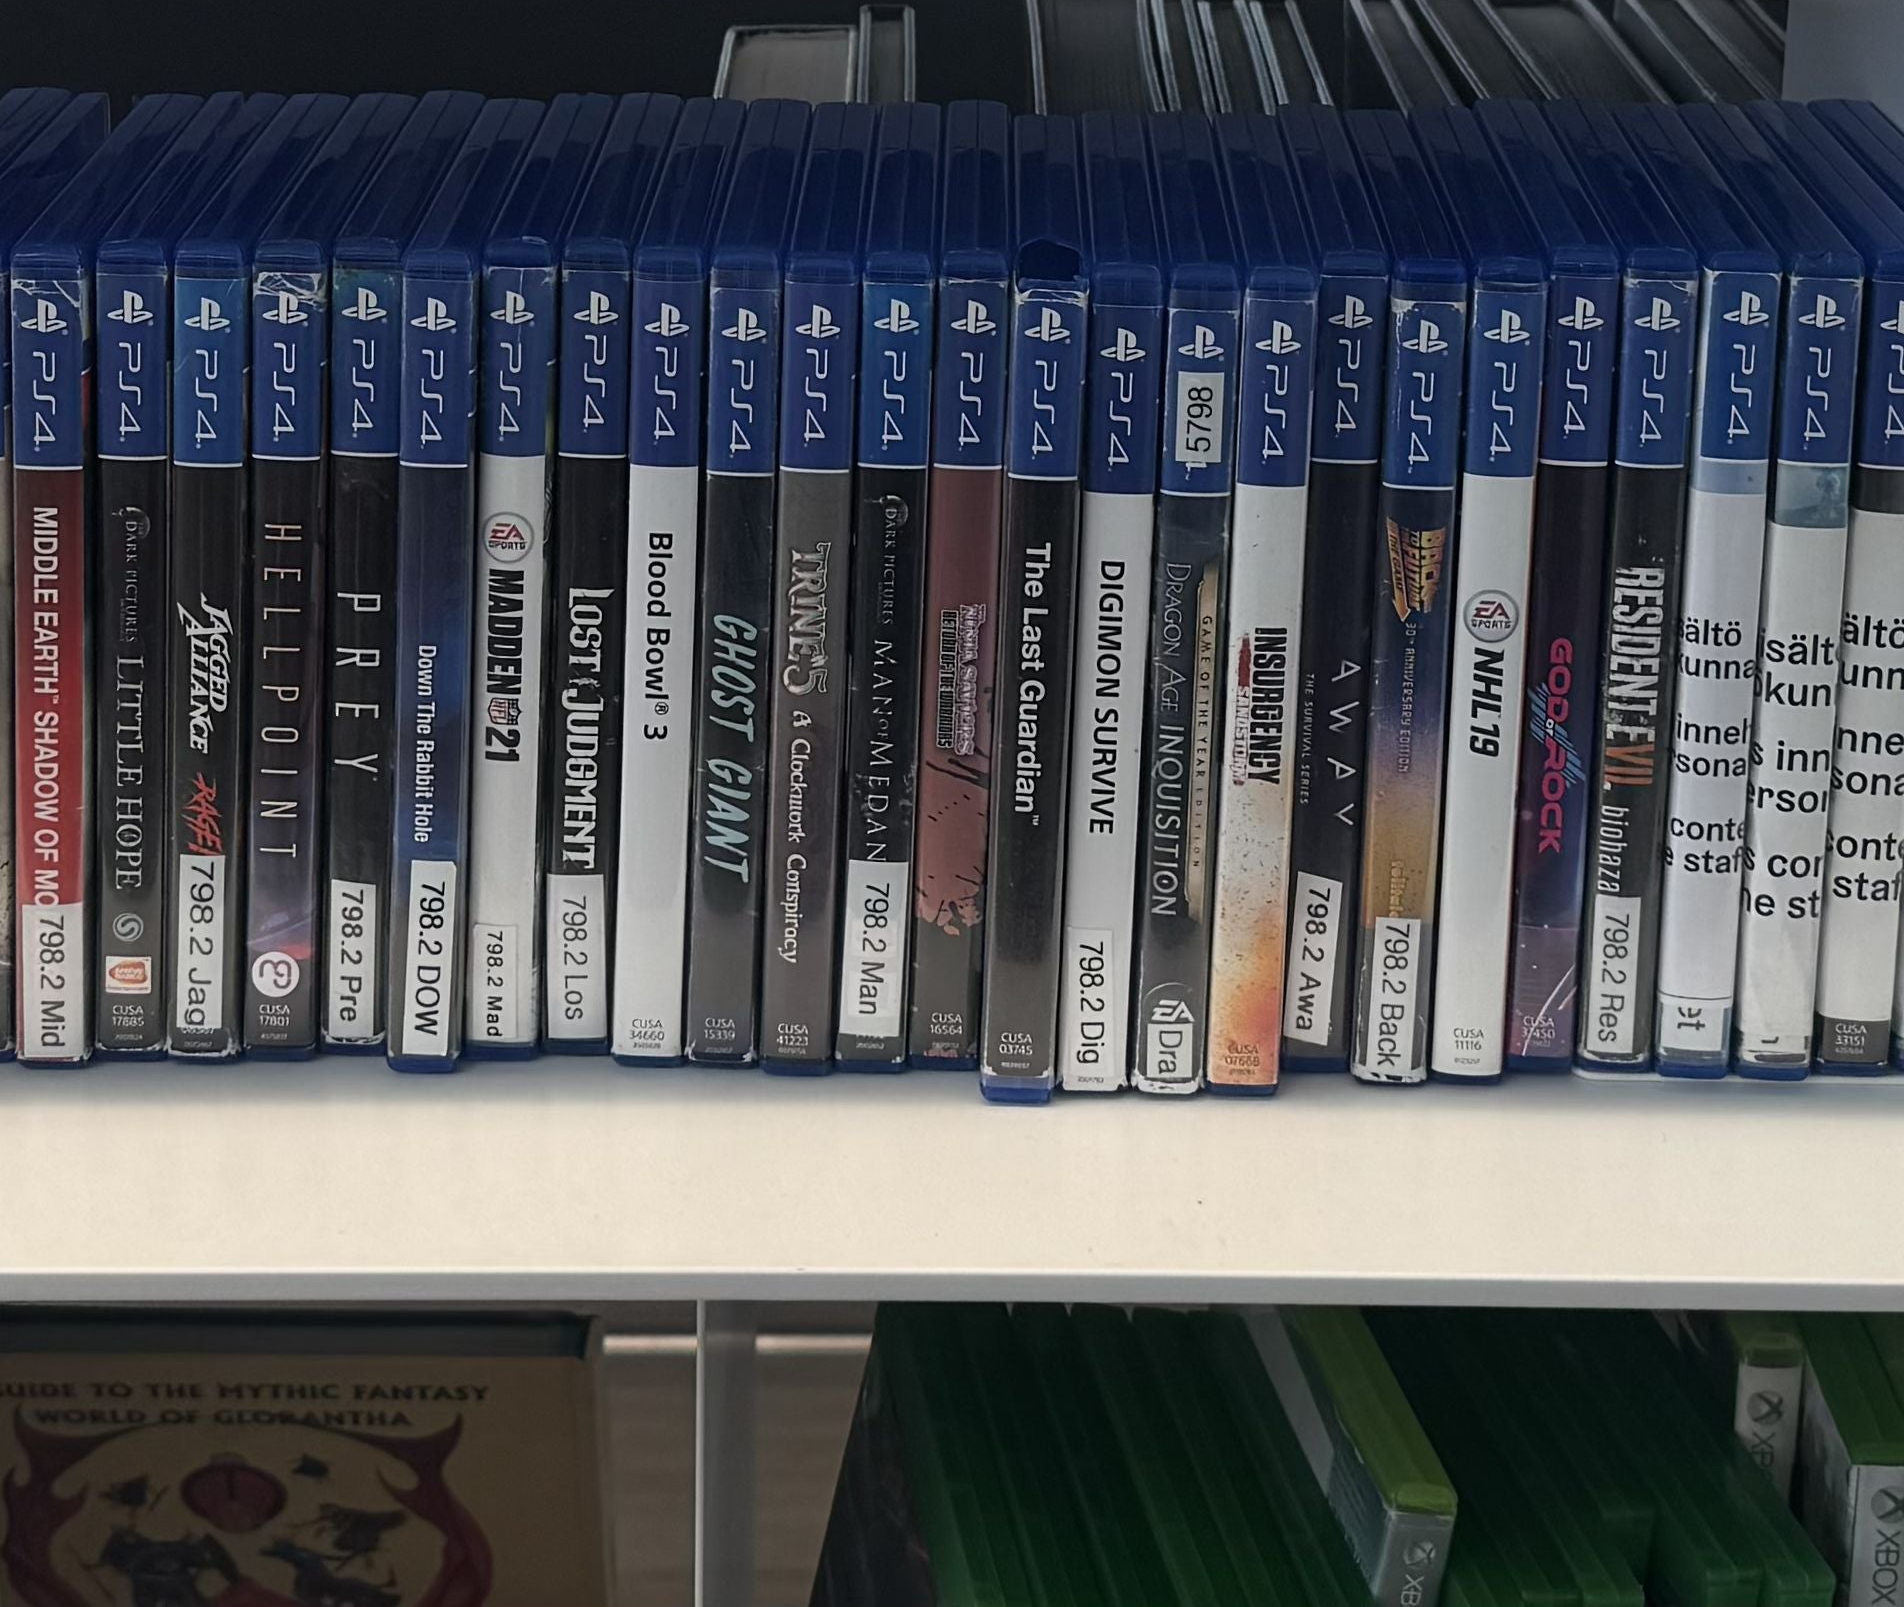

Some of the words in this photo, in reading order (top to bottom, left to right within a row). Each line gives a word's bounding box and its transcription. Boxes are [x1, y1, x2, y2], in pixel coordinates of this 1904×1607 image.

[1186, 385, 1213, 454] 5798
[646, 532, 674, 619] Blood
[1024, 542, 1051, 598] The
[1021, 607, 1047, 672] Last
[1097, 561, 1125, 694] DIGIMON
[416, 645, 437, 696] Down
[710, 614, 757, 743] GHOST
[1246, 626, 1286, 785] INSURGENCY
[116, 655, 144, 786] LITTLE
[416, 701, 435, 734] The
[643, 725, 667, 740] 3
[415, 739, 435, 799] Rabbit
[1090, 708, 1119, 834] SURVIVE
[116, 796, 144, 890] HOPE
[414, 805, 433, 843] Hole
[702, 757, 752, 883] GIANT
[418, 881, 446, 955] 798.2
[1078, 941, 1104, 1013] 798.2
[1382, 922, 1411, 994] 798.2
[415, 965, 441, 1036] DOW
[1376, 1001, 1405, 1067] Back
[1076, 1019, 1104, 1064] Dig
[353, 1383, 489, 1402] FANTASY
